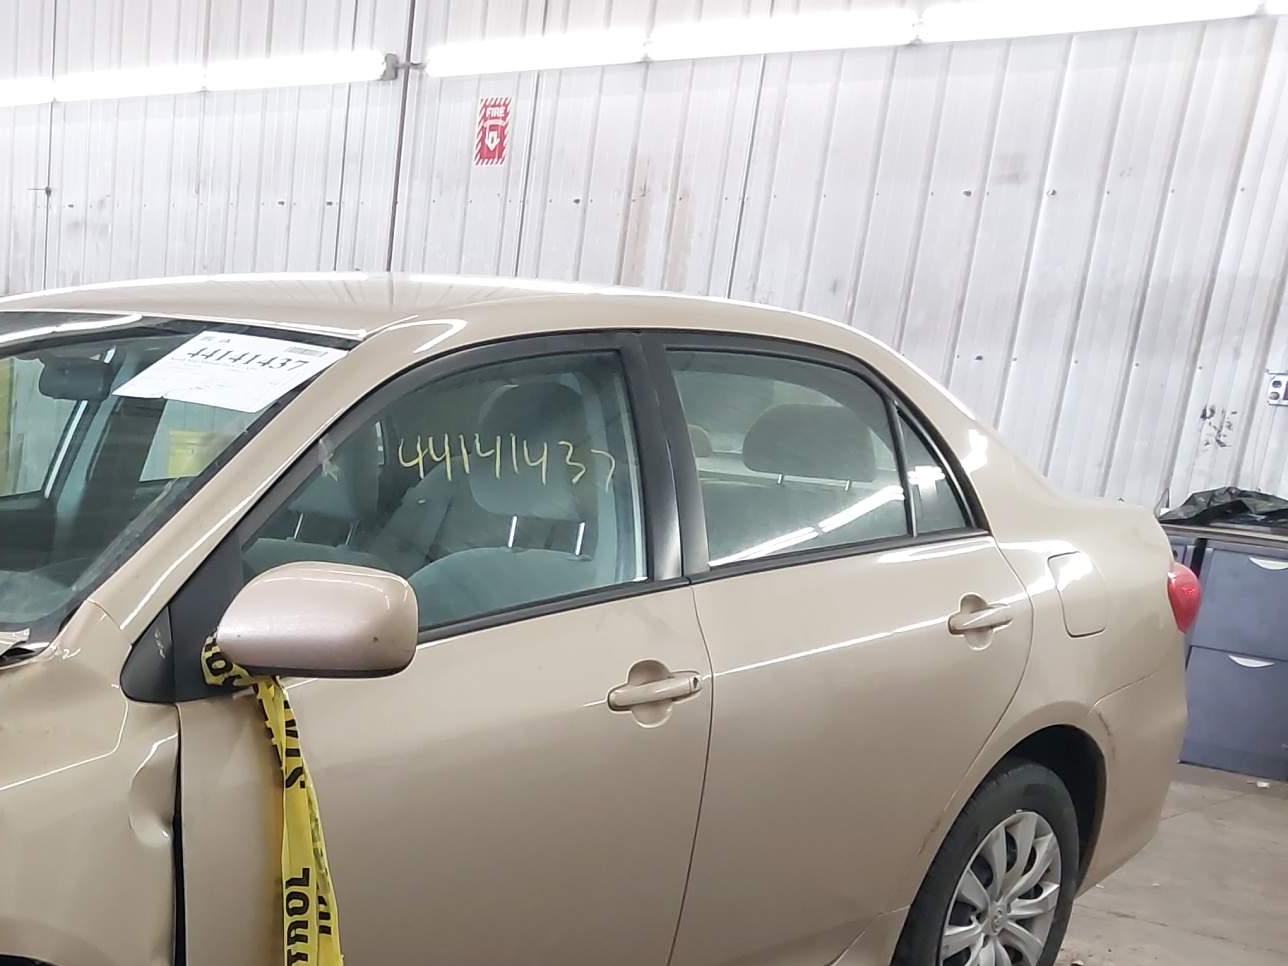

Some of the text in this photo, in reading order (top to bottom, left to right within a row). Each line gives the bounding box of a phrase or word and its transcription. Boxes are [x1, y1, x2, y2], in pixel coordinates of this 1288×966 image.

[486, 106, 506, 118] FIRE
[187, 346, 310, 371] 44141437
[398, 433, 616, 493] 44141437
